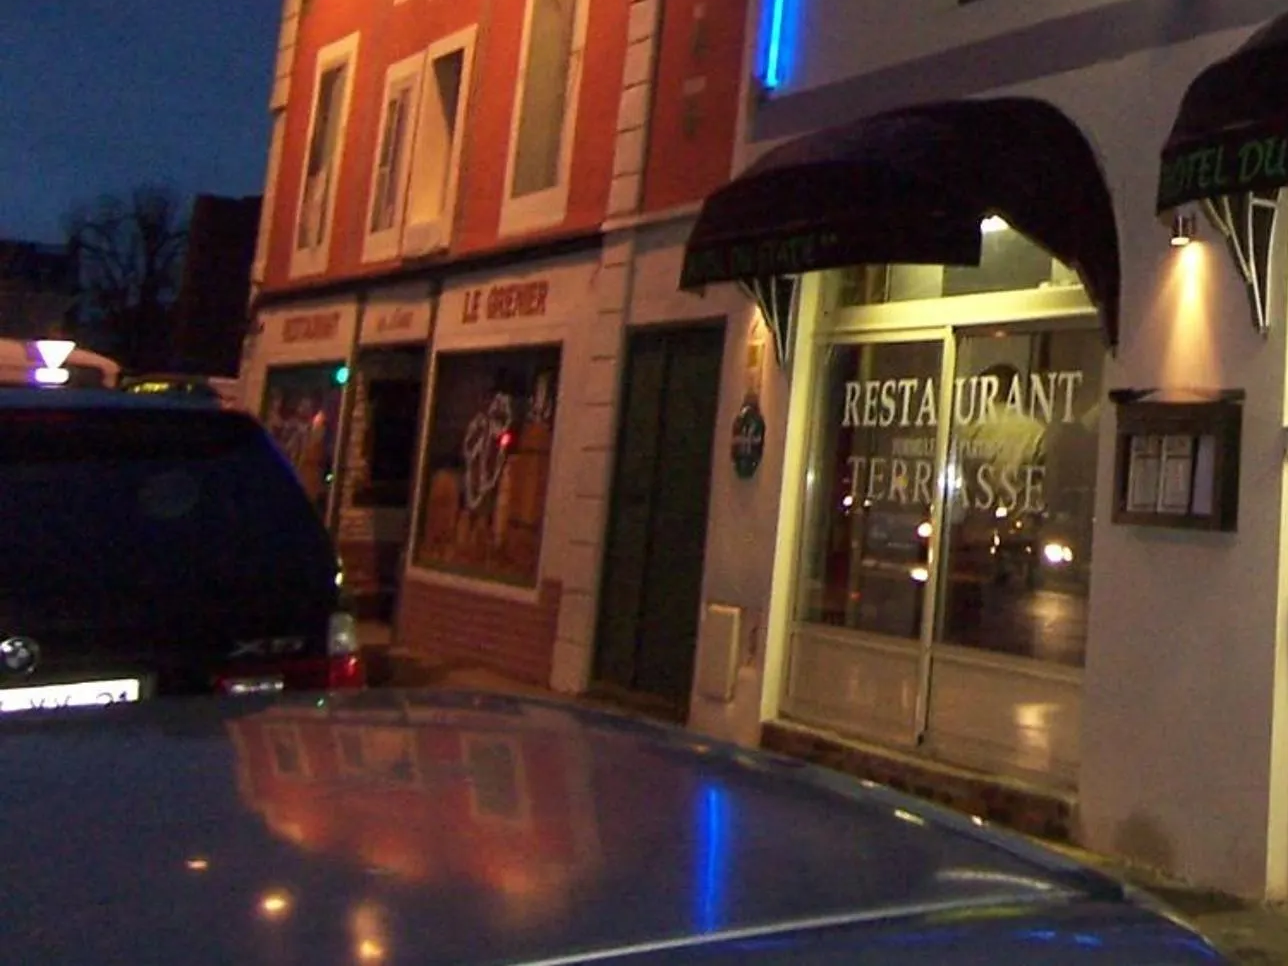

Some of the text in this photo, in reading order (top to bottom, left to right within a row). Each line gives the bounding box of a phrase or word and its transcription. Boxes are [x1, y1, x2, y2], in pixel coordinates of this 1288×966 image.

[1238, 136, 1288, 183] DU
[462, 289, 482, 324] LE
[842, 371, 1083, 427] RESTAURANT
